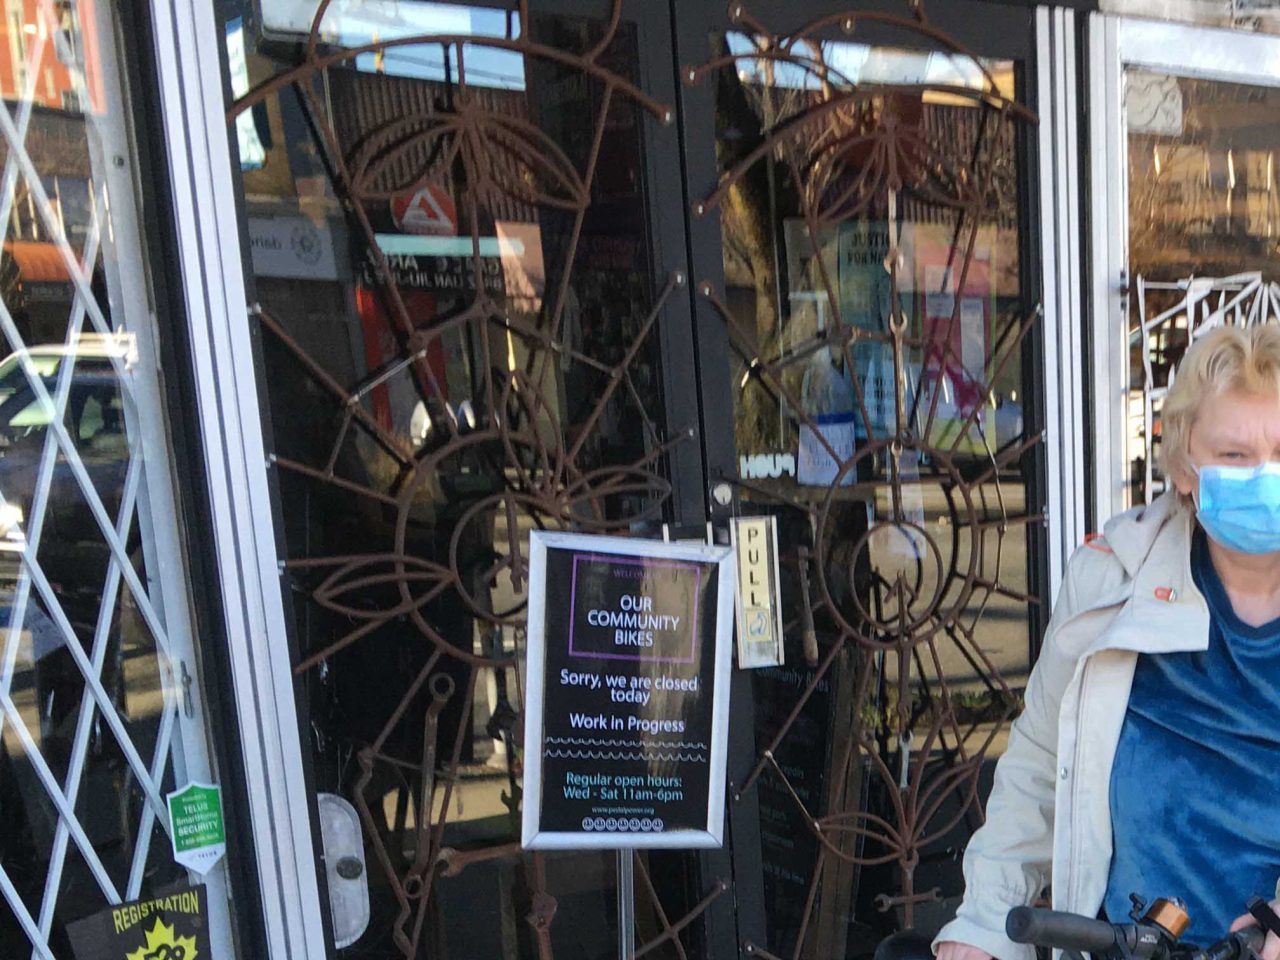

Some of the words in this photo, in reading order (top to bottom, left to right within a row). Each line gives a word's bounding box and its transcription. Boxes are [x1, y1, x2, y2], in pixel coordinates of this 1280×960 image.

[747, 528, 762, 608] PULL
[620, 594, 652, 612] OUR
[587, 609, 680, 631] COMMUNITY
[614, 628, 653, 647] BIKES
[560, 668, 601, 690] Sorry,
[605, 674, 625, 688] we
[630, 676, 650, 690] are
[654, 674, 698, 692] closed
[610, 688, 650, 706] today
[569, 713, 607, 730] Work
[627, 715, 685, 735] Progress
[566, 771, 611, 787] Regular
[614, 776, 644, 791] open
[647, 773, 683, 788] hours:
[563, 785, 590, 800] Wed
[600, 787, 618, 800] Sat
[622, 788, 683, 803] 11am-6pm
[178, 820, 218, 837] SECURITY
[112, 890, 200, 935] REGISTRATION
